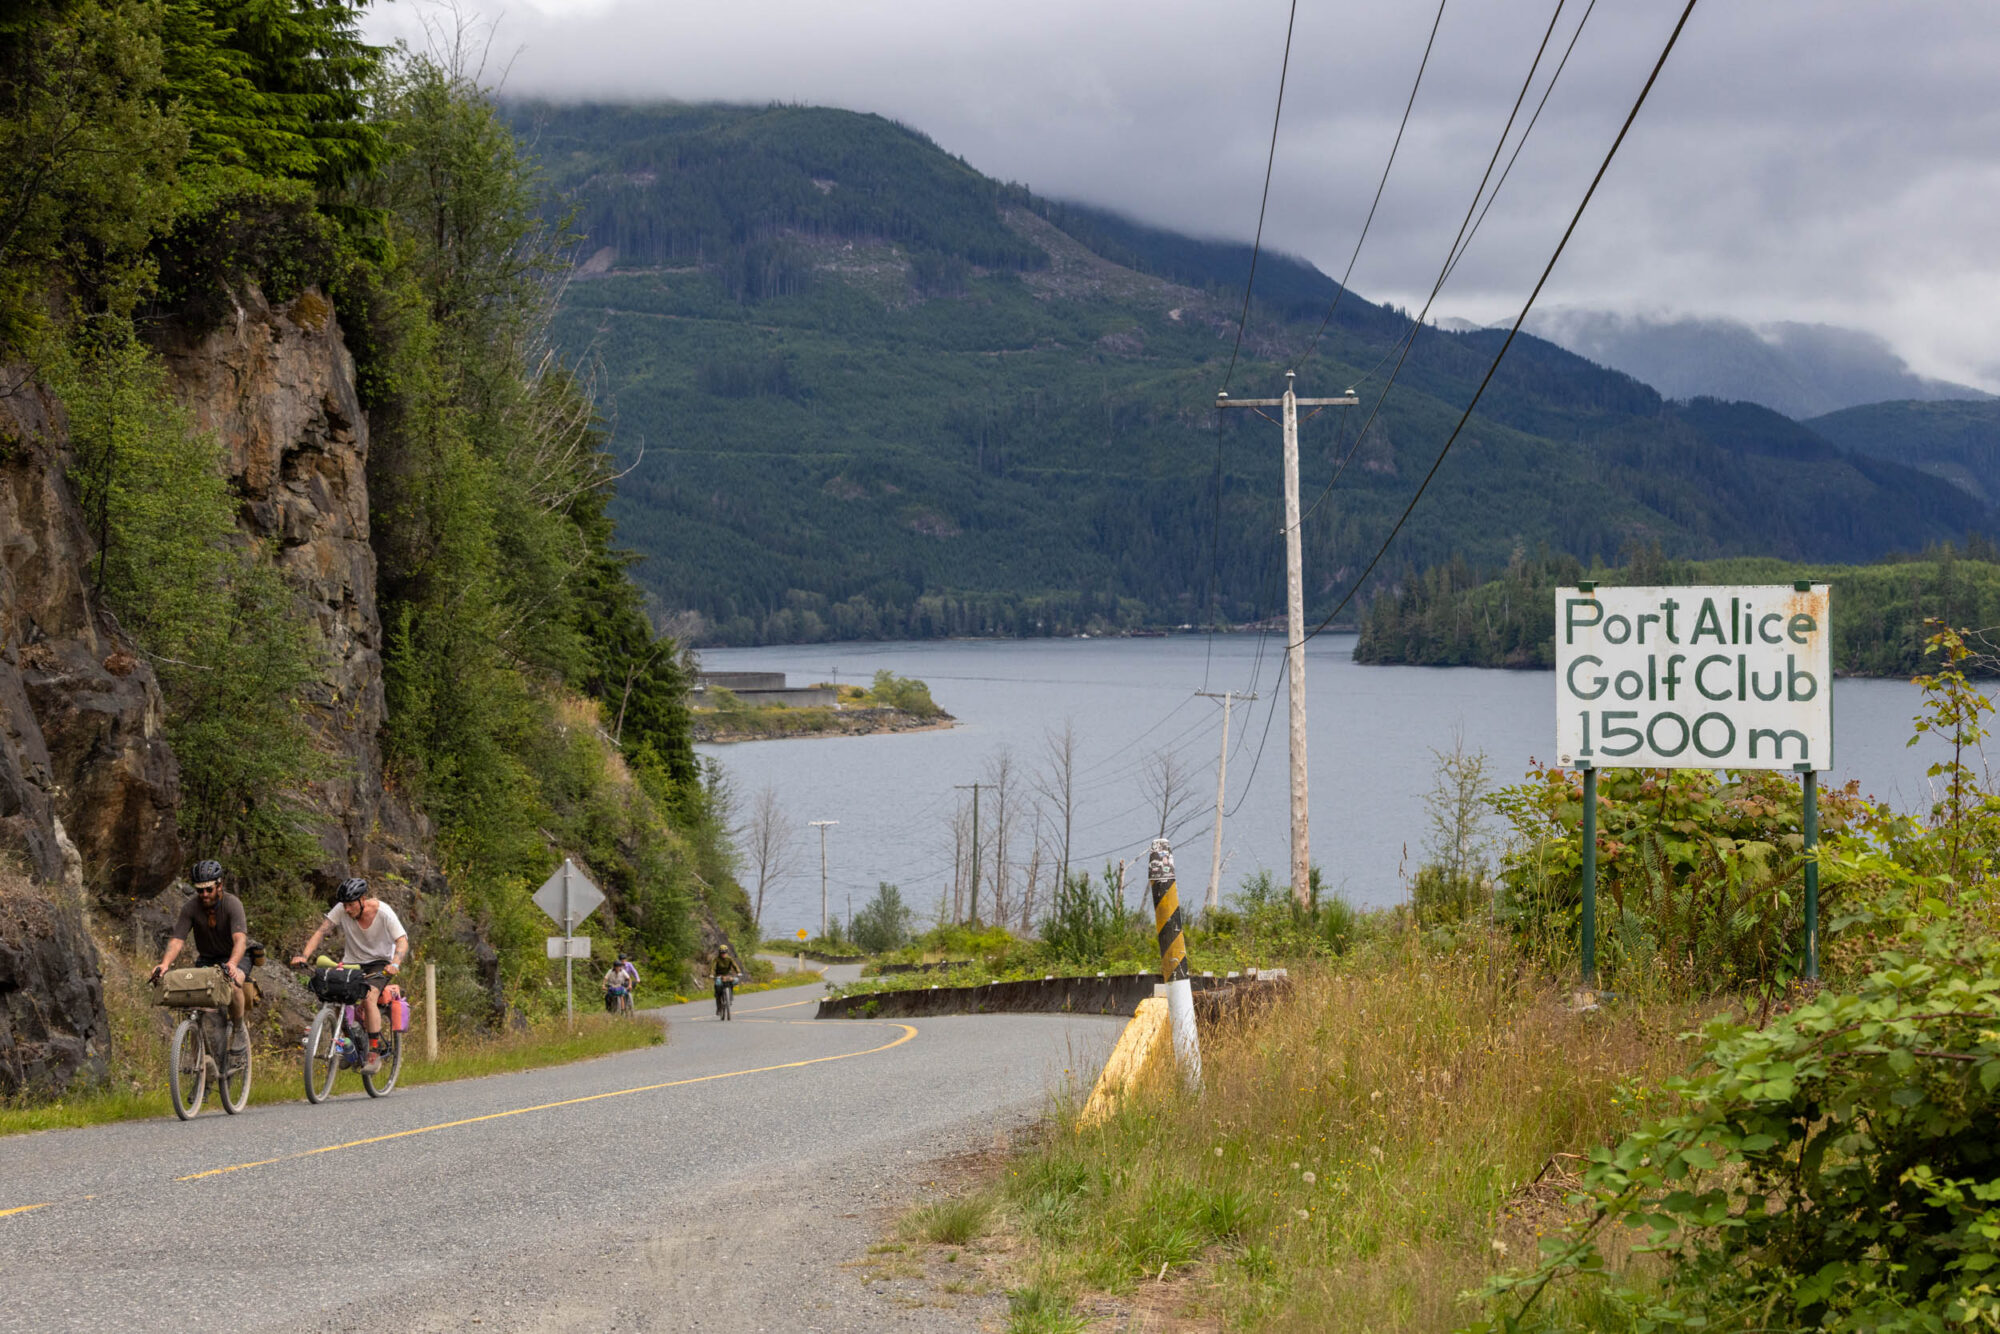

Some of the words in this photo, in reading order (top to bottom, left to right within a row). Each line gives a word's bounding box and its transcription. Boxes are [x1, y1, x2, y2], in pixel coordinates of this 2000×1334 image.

[1565, 597, 1680, 645] Port
[1689, 597, 1817, 645] Alice
[1566, 654, 1687, 701] Golf
[1694, 654, 1818, 702] Club
[1578, 710, 1736, 758] 1500
[1748, 728, 1809, 760] m
